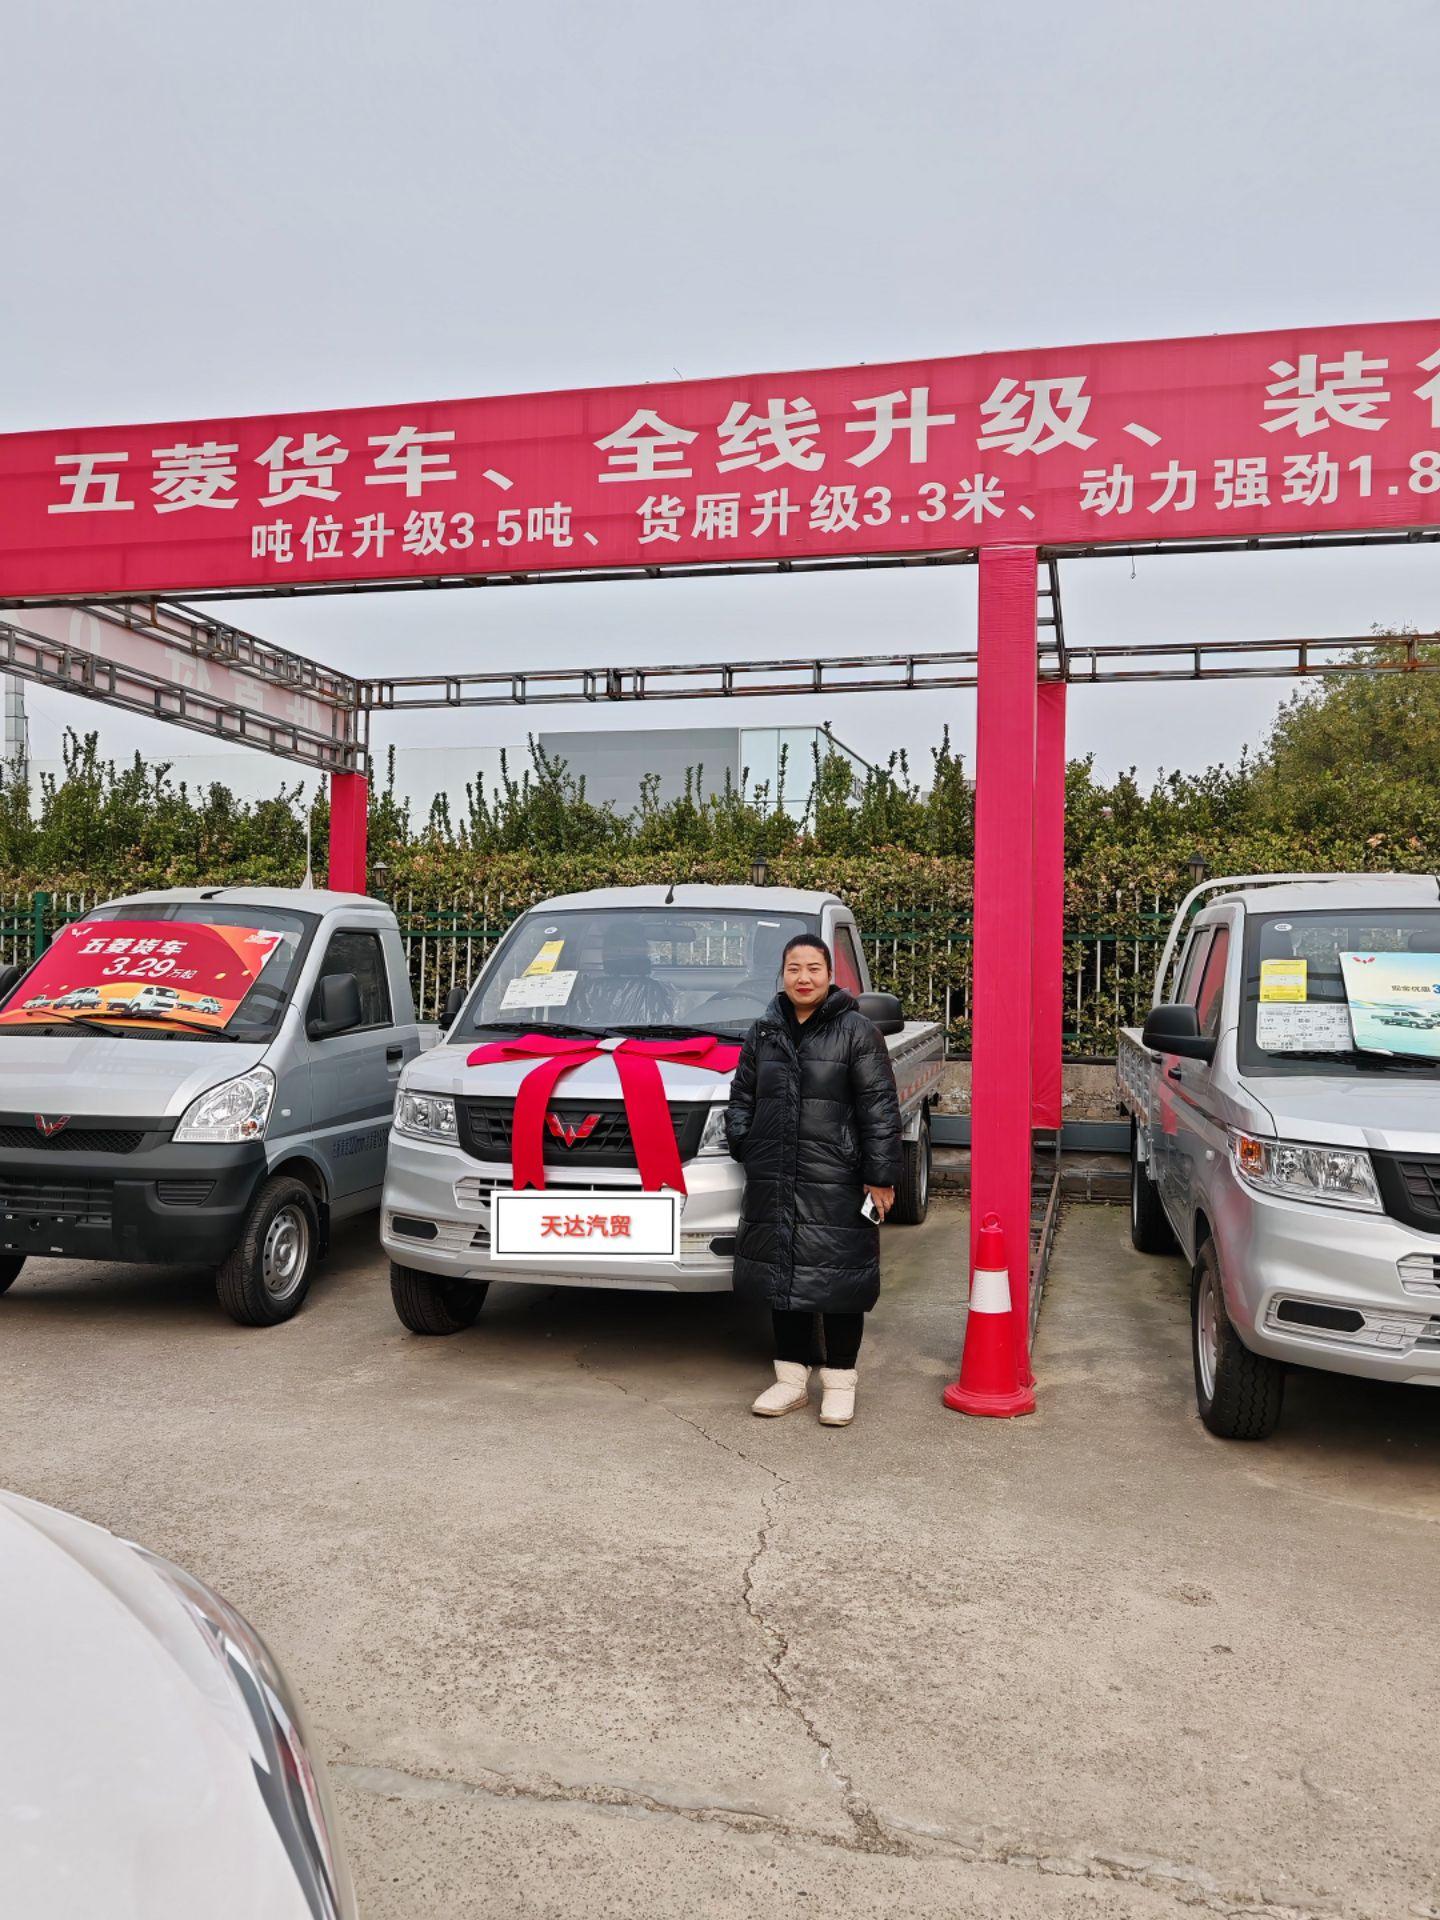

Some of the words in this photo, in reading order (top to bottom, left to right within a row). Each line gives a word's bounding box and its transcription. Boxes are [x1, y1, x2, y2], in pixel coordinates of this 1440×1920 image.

[1259, 348, 1440, 438] 装
[78, 937, 188, 956] 五菱货车
